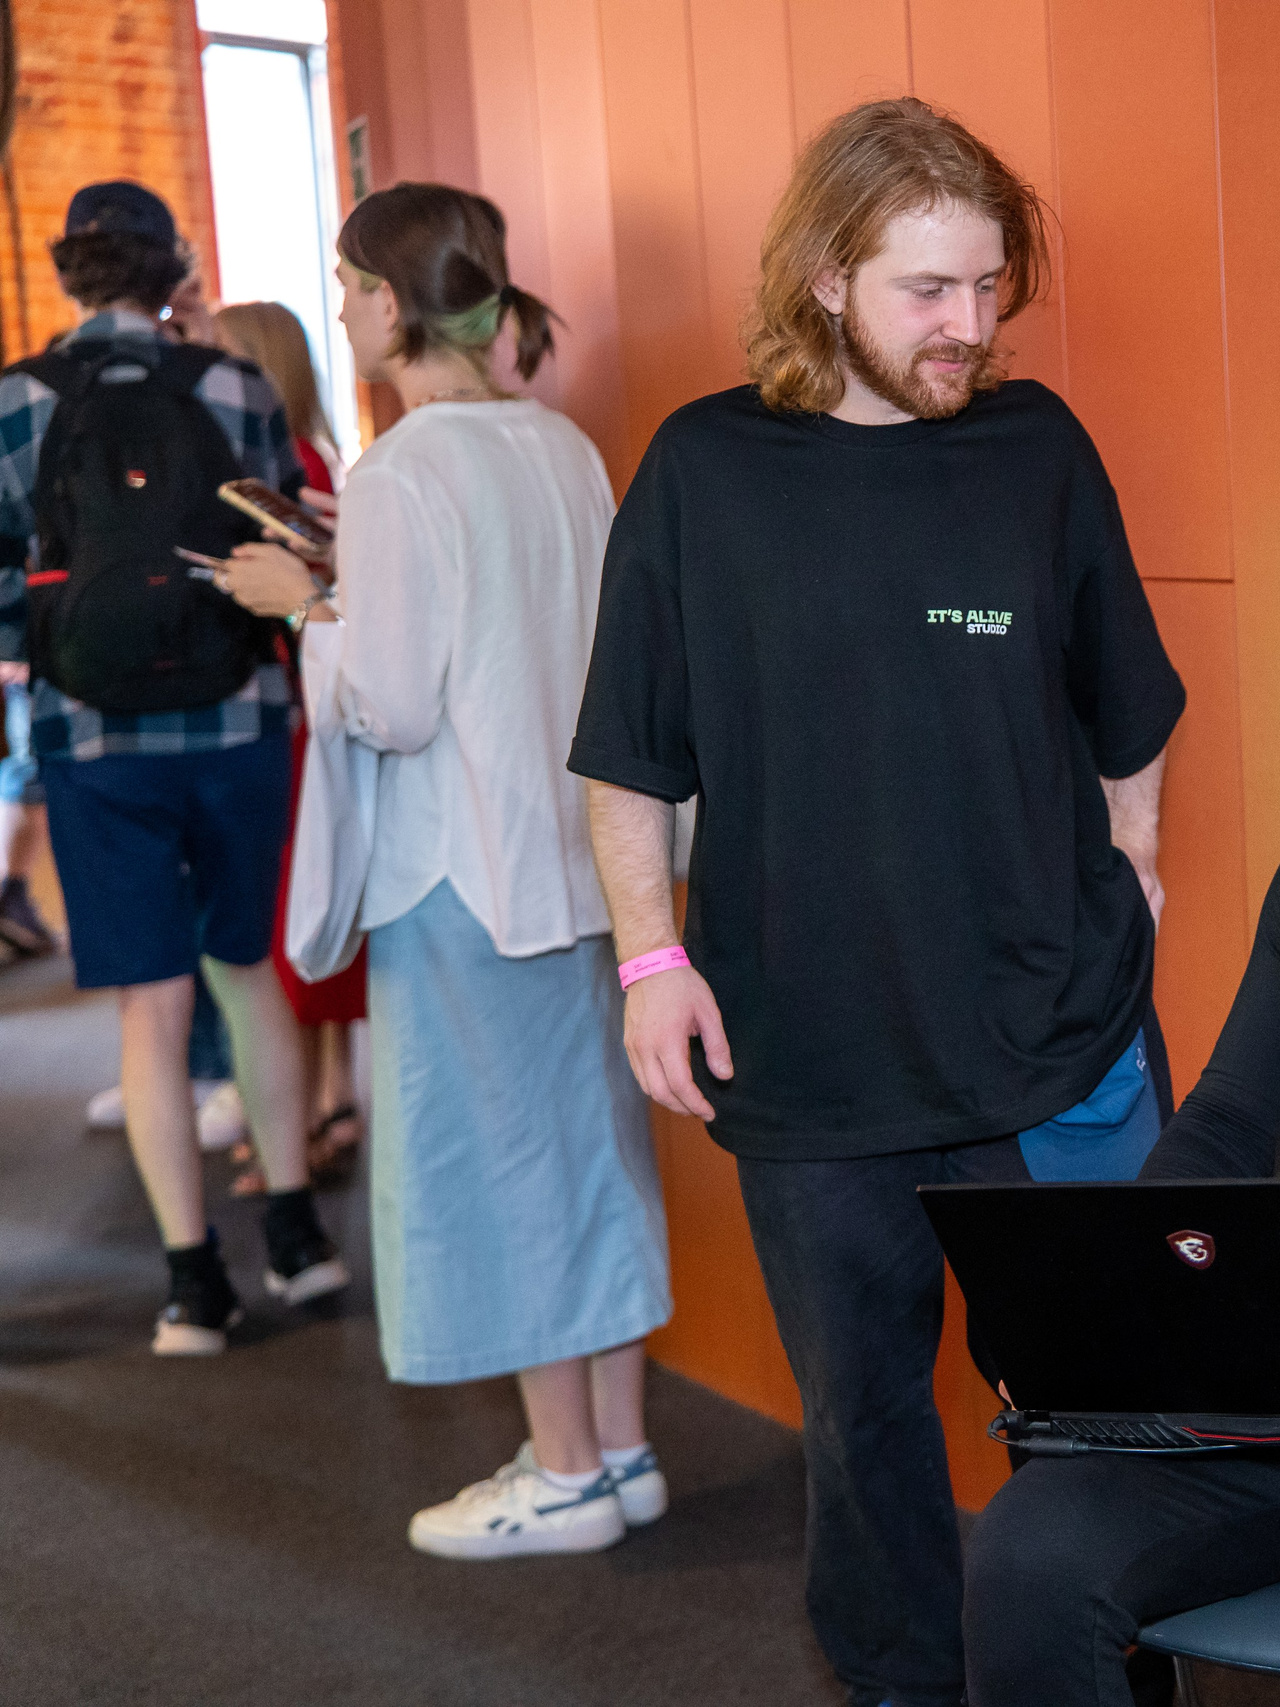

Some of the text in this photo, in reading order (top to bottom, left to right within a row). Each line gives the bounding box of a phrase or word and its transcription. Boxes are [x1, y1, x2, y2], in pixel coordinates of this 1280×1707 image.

[927, 608, 1013, 625] IT'S ALIVE
[966, 623, 1008, 635] STUDIO
